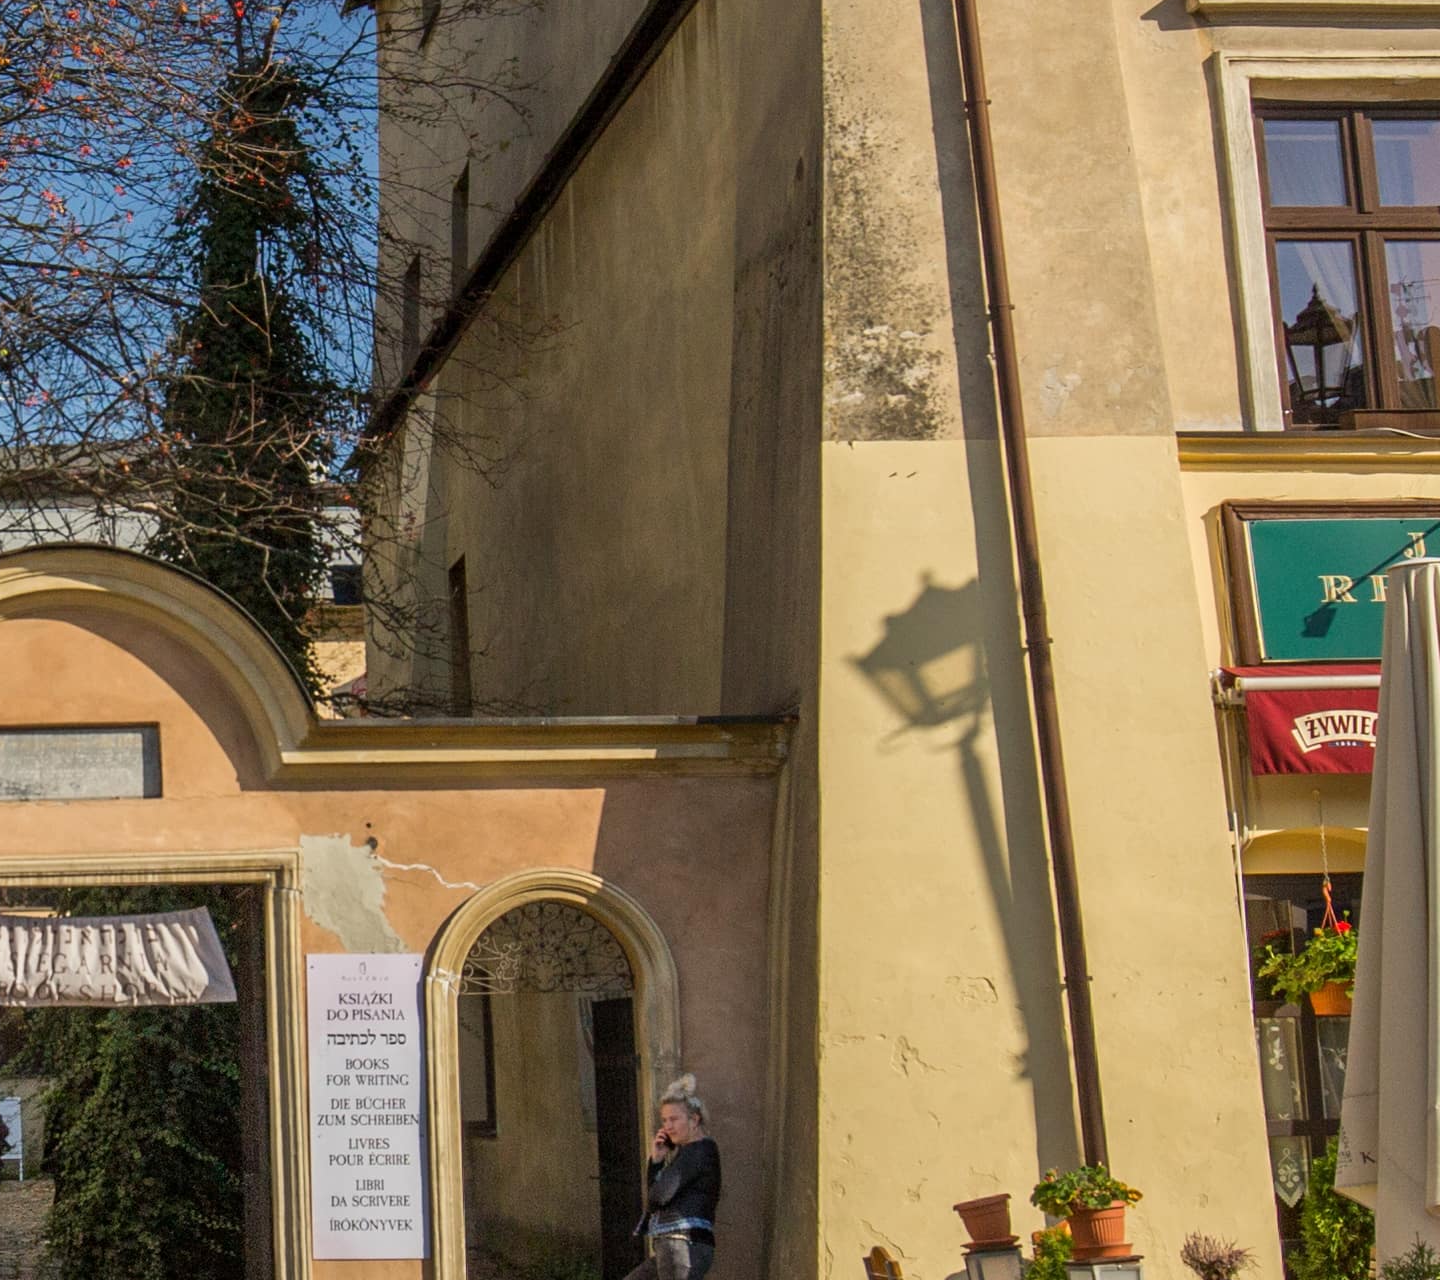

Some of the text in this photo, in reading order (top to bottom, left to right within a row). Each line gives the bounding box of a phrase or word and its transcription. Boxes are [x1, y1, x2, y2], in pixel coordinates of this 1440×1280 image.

[338, 990, 393, 1007] KSIĄŻKI
[327, 1009, 405, 1021] DO PISANIA
[327, 1028, 407, 1046] ספר לכתיבה
[345, 1058, 390, 1070] BOOKS
[326, 1074, 409, 1086] FOR WRITING
[331, 1095, 406, 1110] DIE BÜCHER
[317, 1114, 420, 1126] ZUM SCHREIBEN
[348, 1138, 390, 1150] LIVRES
[329, 1151, 411, 1166] POUR ÉCRIRE
[355, 1179, 385, 1191] LIBRI
[331, 1195, 411, 1208] DA SCRIVERE
